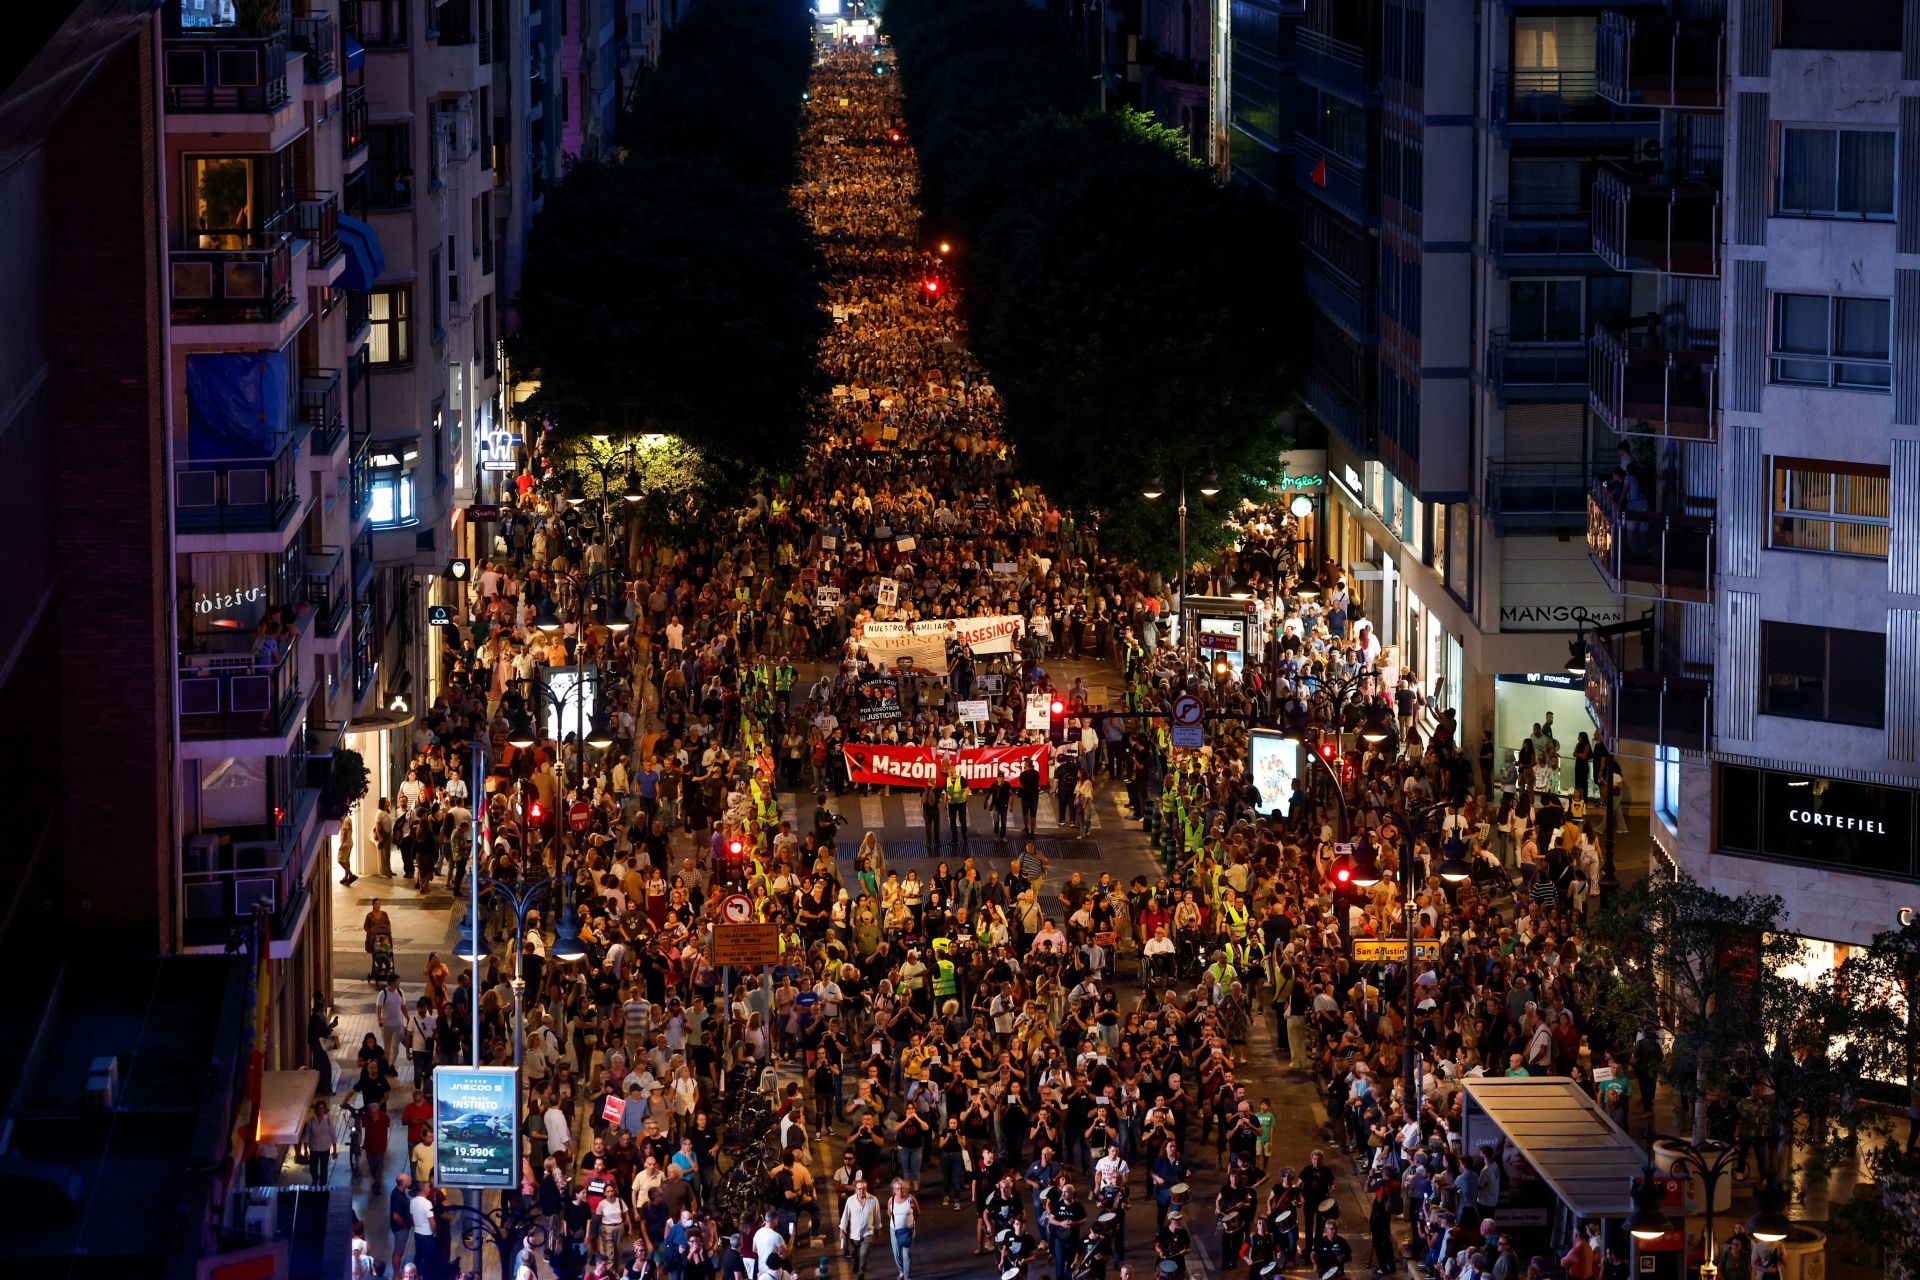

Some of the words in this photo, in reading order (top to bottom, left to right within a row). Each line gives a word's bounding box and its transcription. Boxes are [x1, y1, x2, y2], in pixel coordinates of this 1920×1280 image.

[1281, 470, 1323, 491] Inglés
[1501, 605, 1588, 622] MANGO
[1591, 612, 1620, 621] MAN
[965, 619, 1021, 645] ASESINOS
[1543, 674, 1571, 684] movistar
[872, 754, 937, 779] Mazón
[1789, 810, 1885, 834] CORTEFIEL
[452, 1099, 498, 1110] INSTINTO
[454, 1147, 496, 1157] 19.990€
